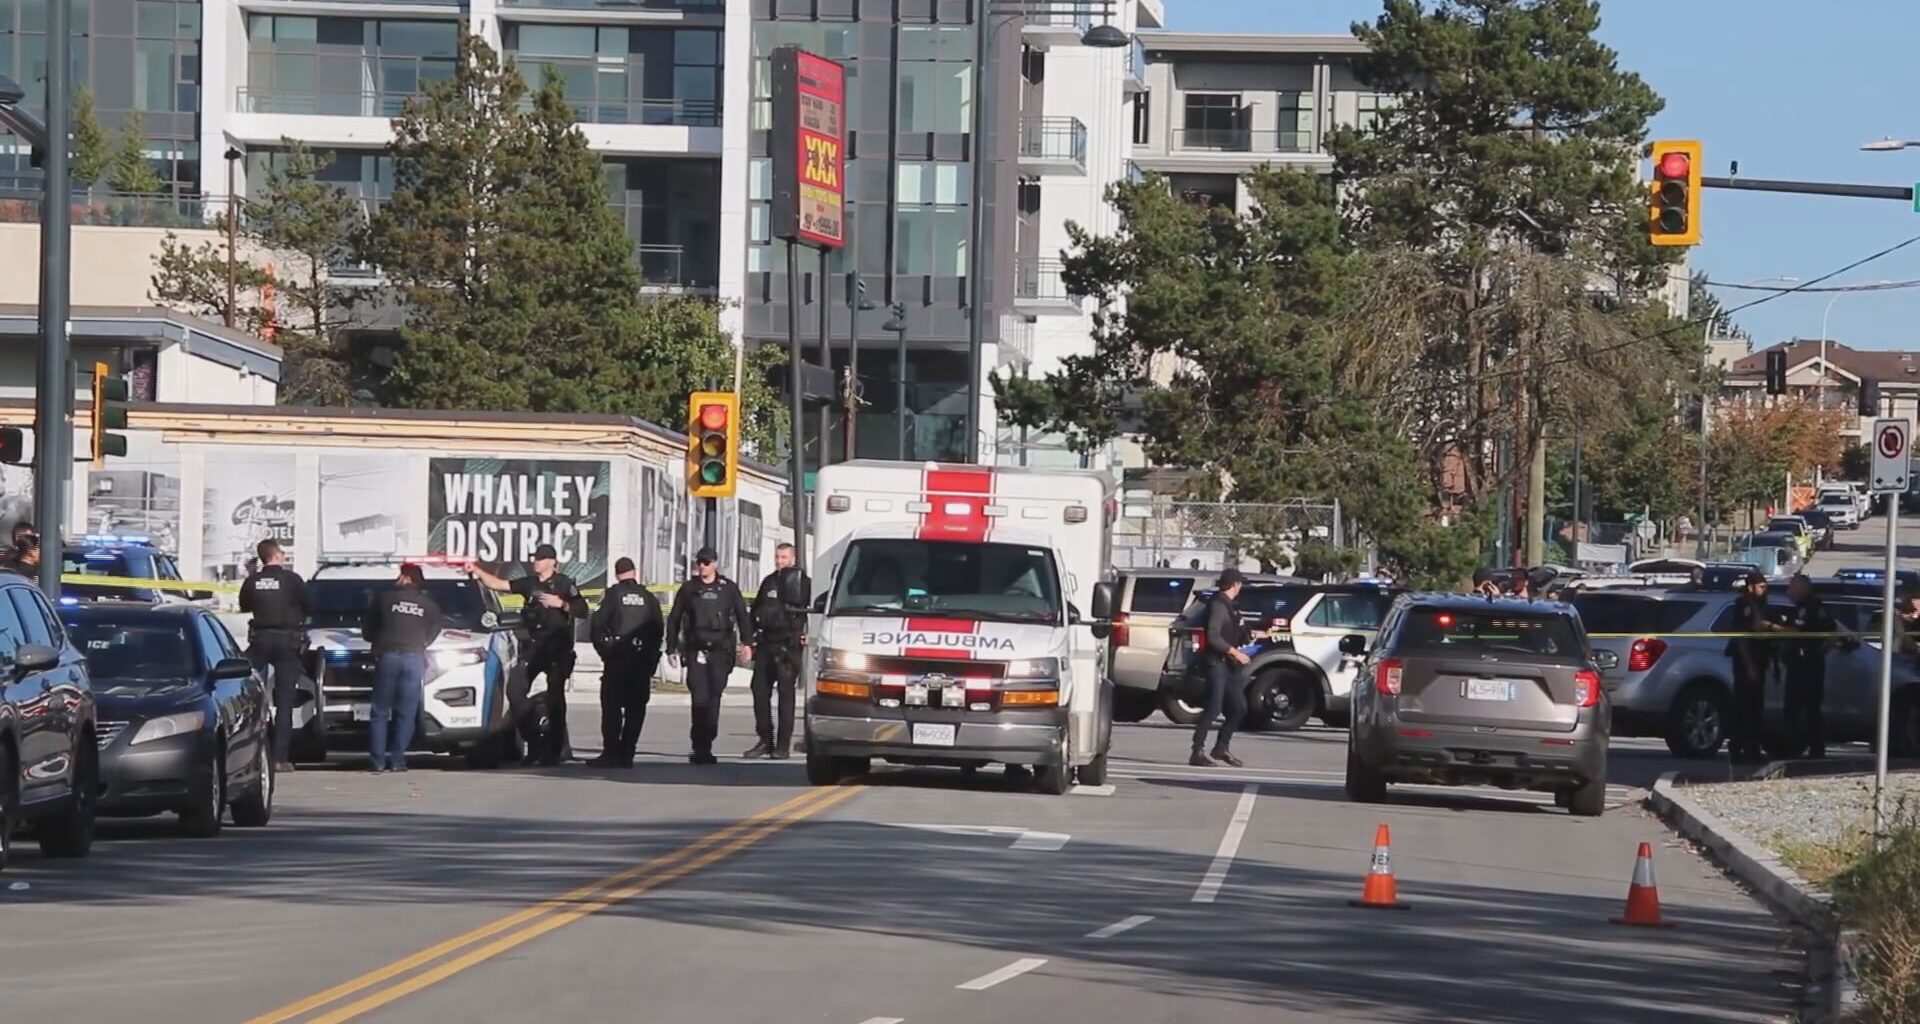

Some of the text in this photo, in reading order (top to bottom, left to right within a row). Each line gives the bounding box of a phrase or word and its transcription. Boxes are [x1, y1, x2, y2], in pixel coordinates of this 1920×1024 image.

[805, 135, 837, 187] XXX
[444, 473, 595, 516] WHALLEY
[446, 520, 593, 563] DISTRICT
[392, 604, 425, 617] POLICE
